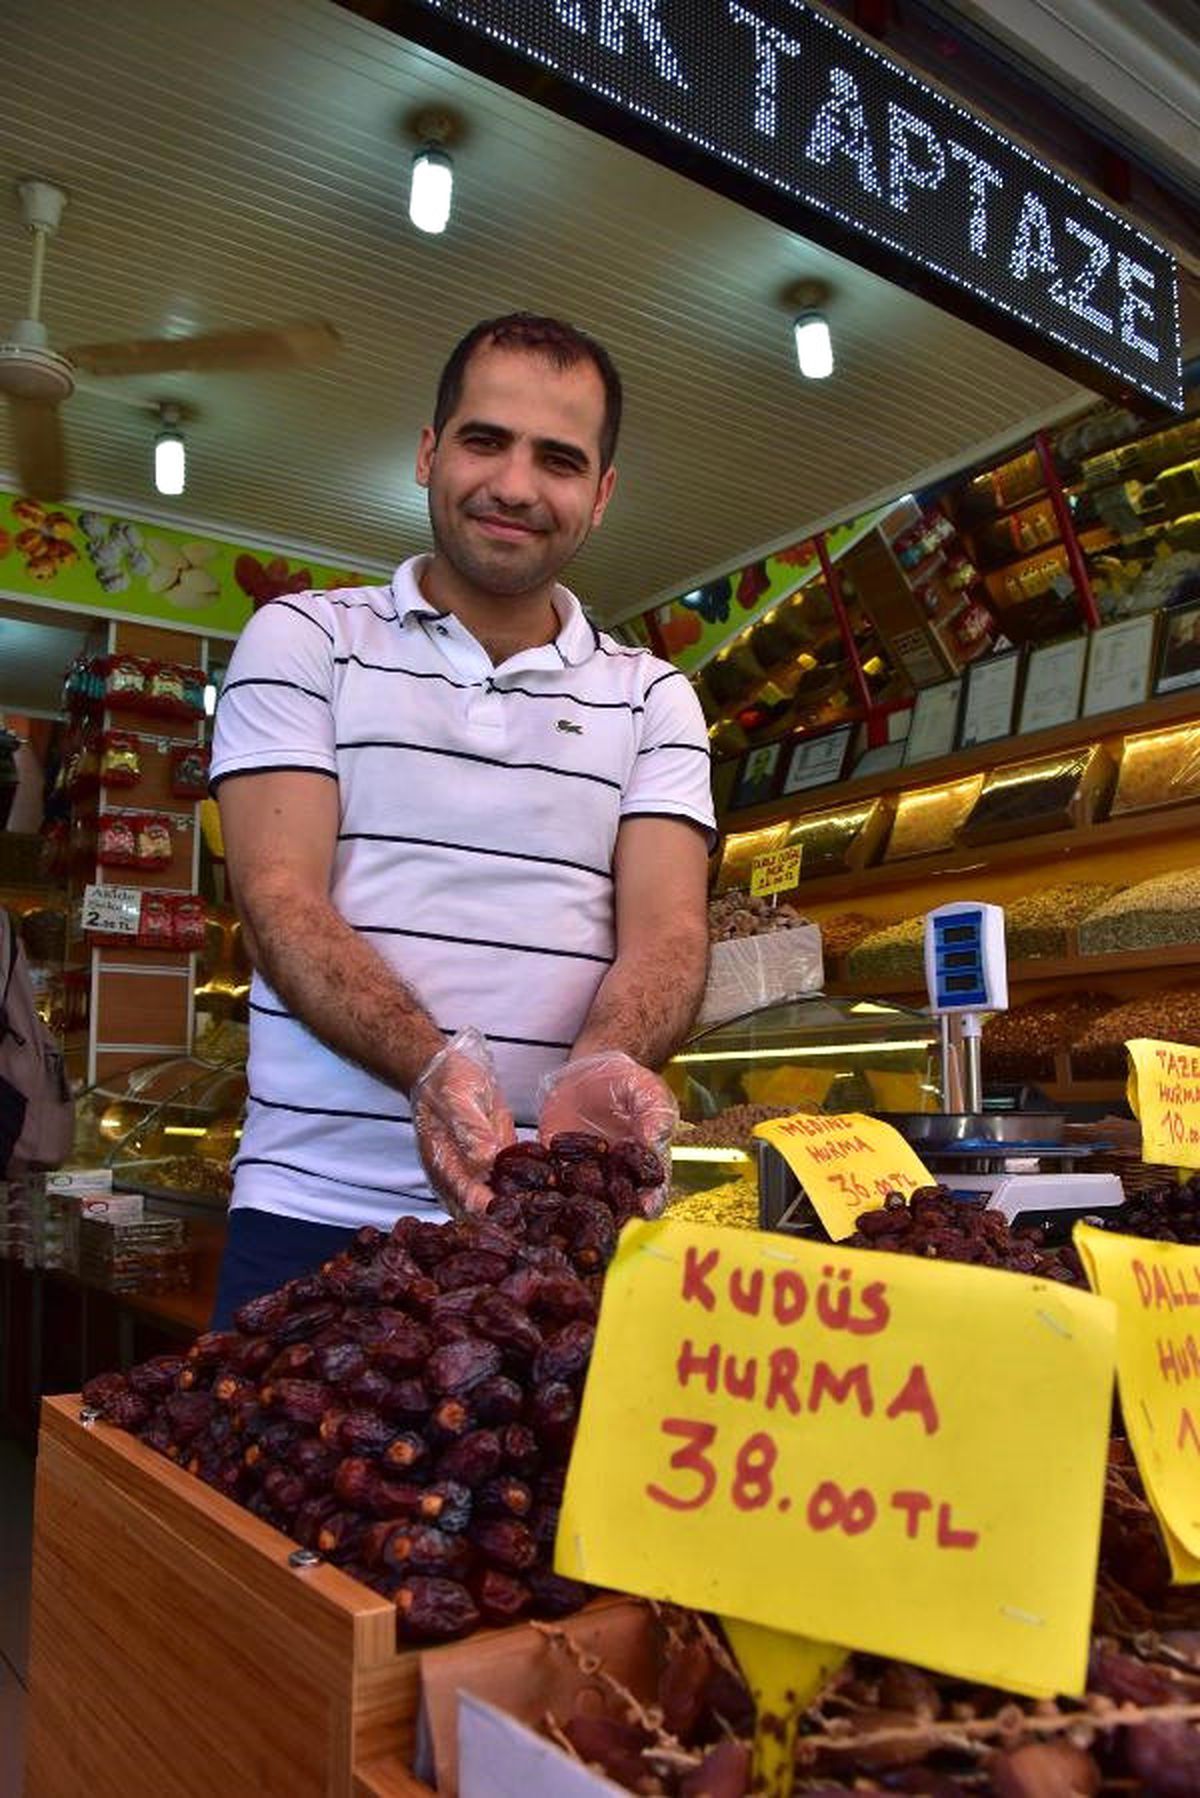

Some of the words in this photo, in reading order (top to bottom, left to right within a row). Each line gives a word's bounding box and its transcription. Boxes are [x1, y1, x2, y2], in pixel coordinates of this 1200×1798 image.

[729, 0, 1160, 363] TAPTAZE
[1156, 1049, 1200, 1078] TAZE
[805, 1135, 876, 1163] HURMA
[681, 1246, 891, 1336] KUDÜS
[677, 1340, 940, 1436] HURMA
[646, 1418, 877, 1536] 38.00
[891, 1490, 979, 1550] TL
